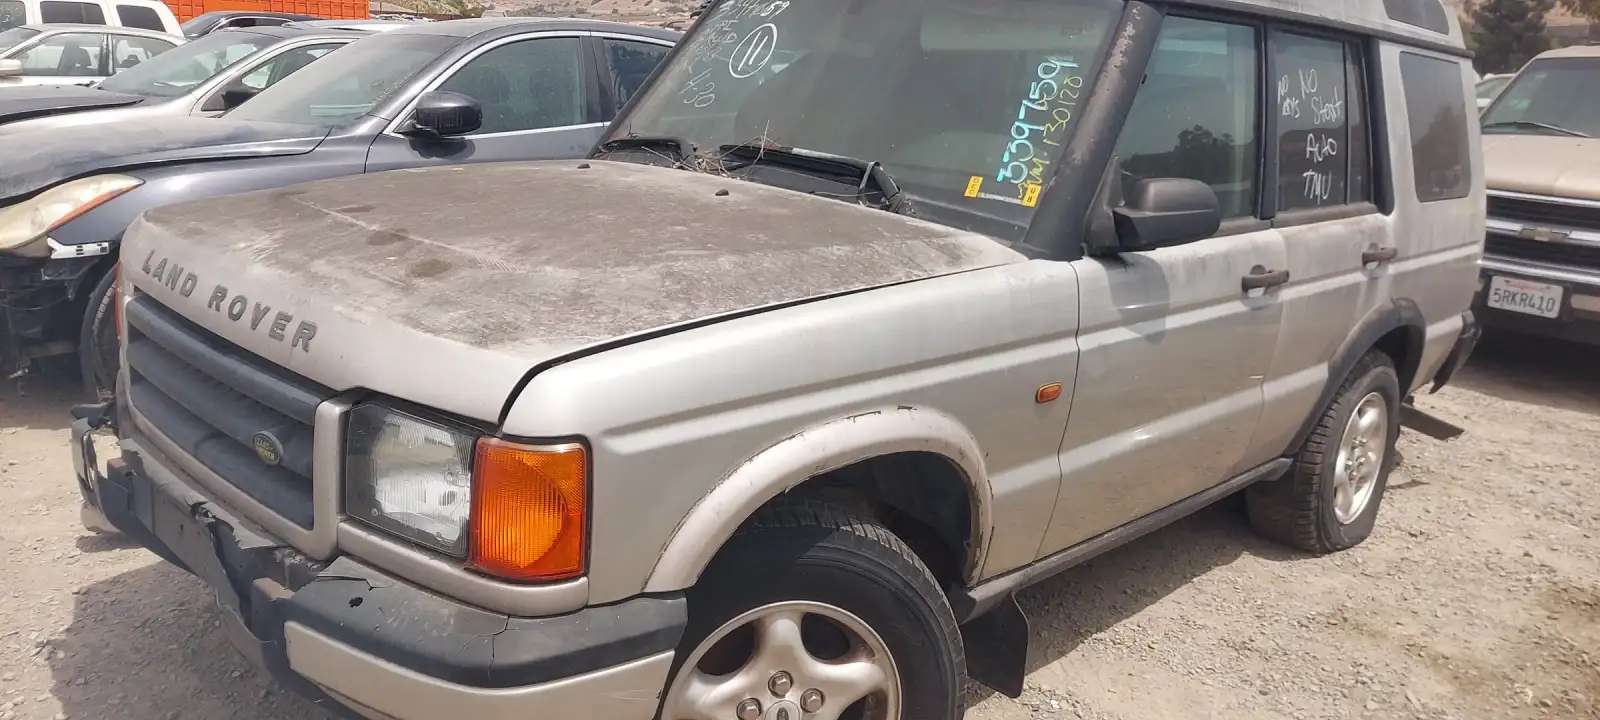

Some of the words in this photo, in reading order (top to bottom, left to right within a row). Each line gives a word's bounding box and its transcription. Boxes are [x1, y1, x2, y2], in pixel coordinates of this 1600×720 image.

[1299, 68, 1318, 99] NO
[141, 249, 199, 298] LAND
[207, 284, 317, 353] ROVER
[1493, 287, 1556, 313] 5RKR410
